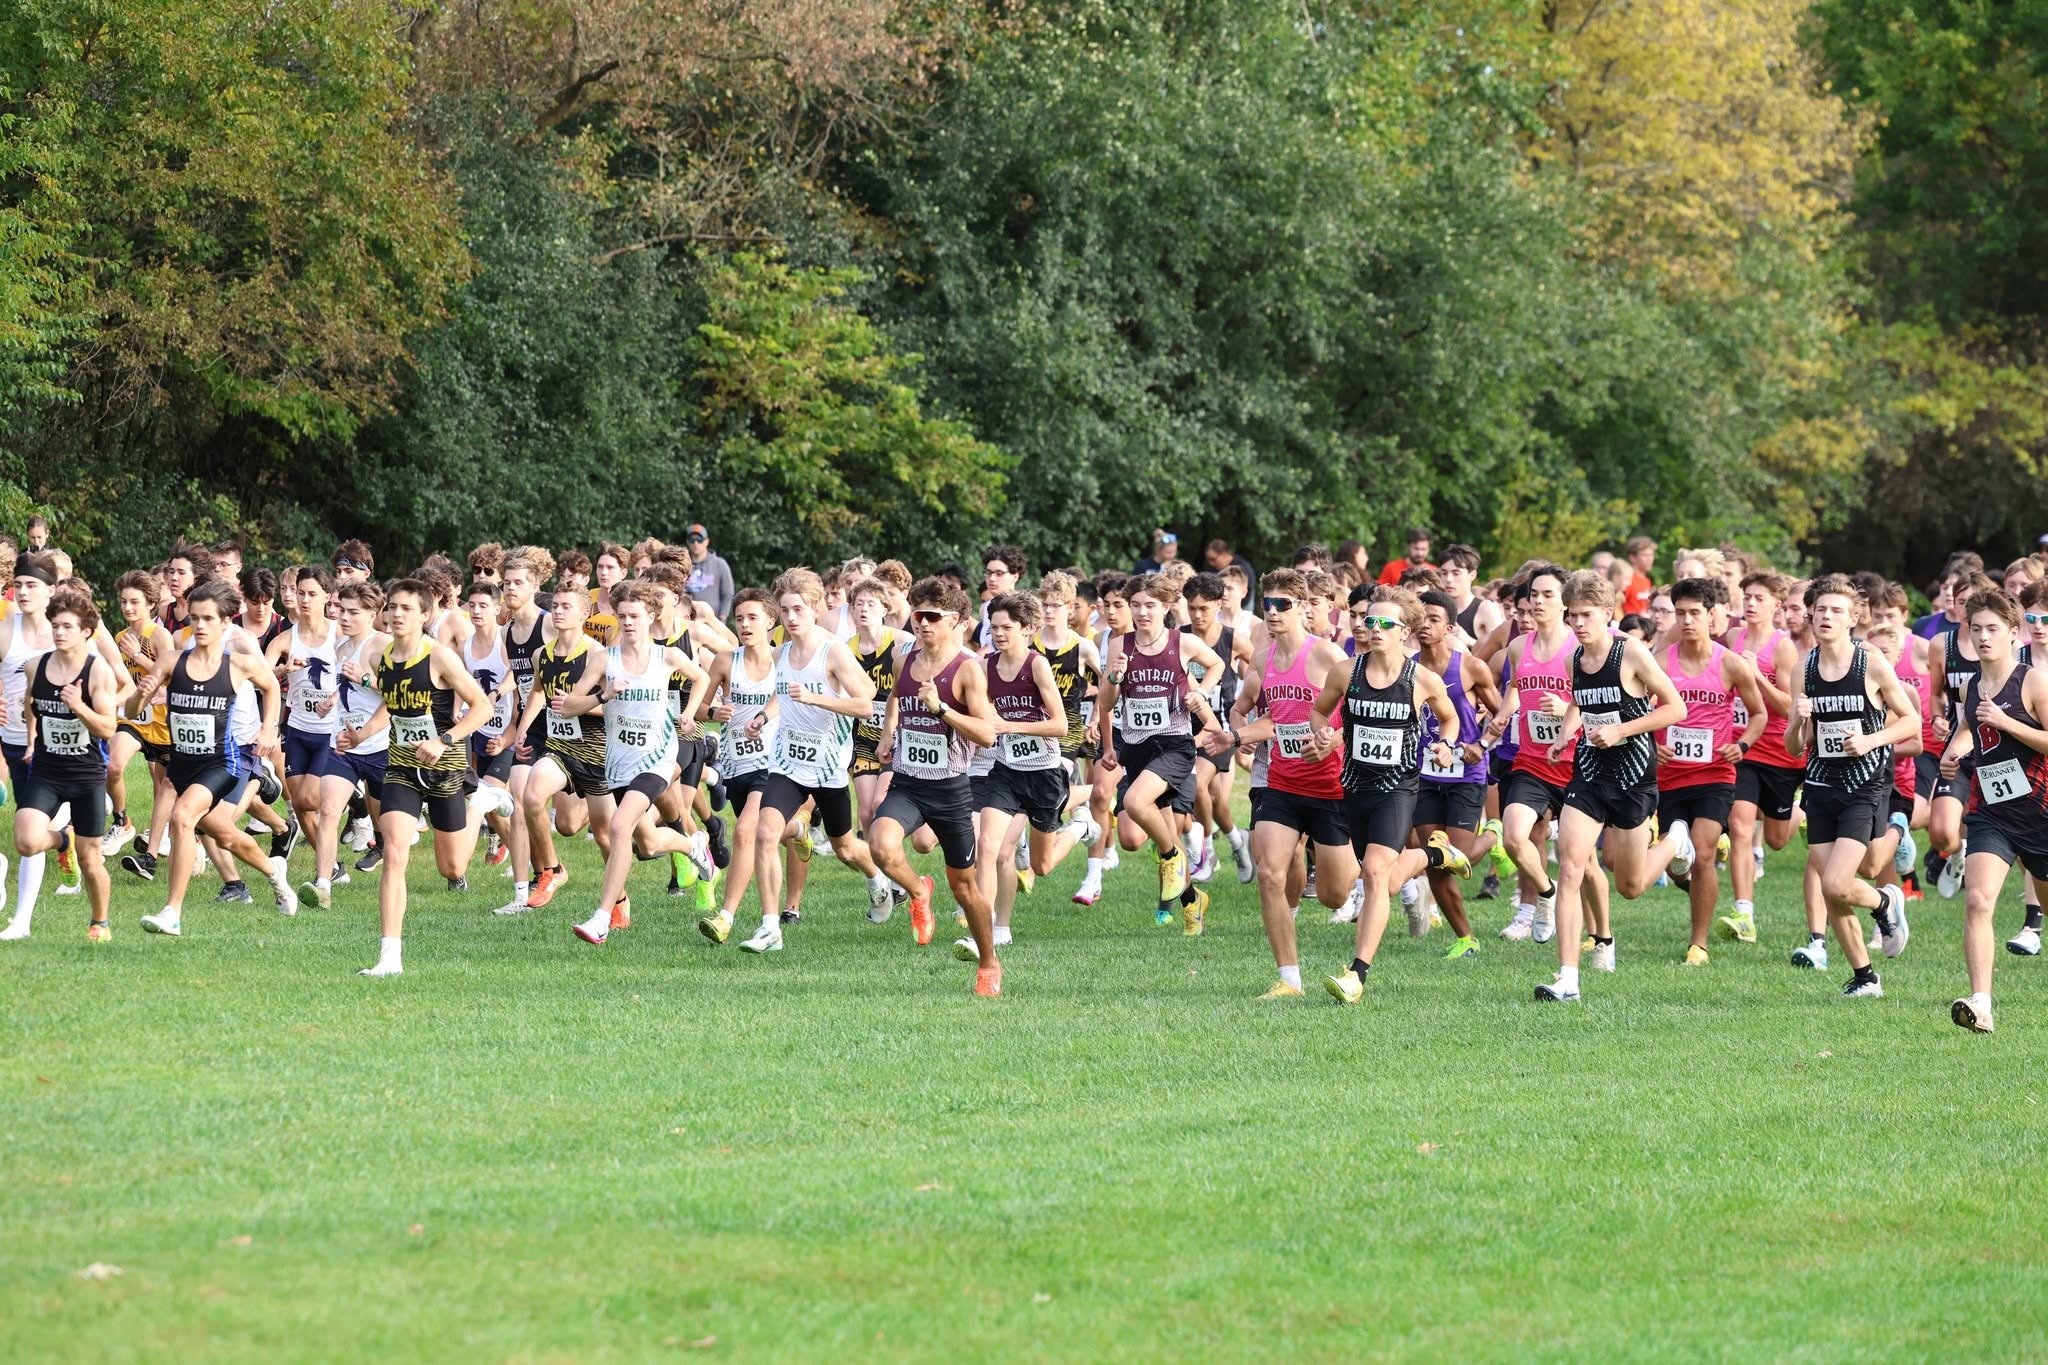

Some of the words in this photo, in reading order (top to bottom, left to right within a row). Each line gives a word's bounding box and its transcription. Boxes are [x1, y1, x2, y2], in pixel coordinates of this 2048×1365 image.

[1127, 669, 1175, 684] CENTRAL
[171, 692, 209, 709] CHRISTIAN
[210, 696, 227, 710] LIFE
[400, 678, 433, 714] Troy
[615, 689, 661, 701] EENDALE
[1265, 685, 1313, 702] RONCOS
[1679, 689, 1726, 706] ONCOS
[1812, 695, 1864, 713] ATERFORD
[625, 721, 652, 729] RUNNER
[1134, 712, 1162, 726] 879
[177, 728, 206, 744] 605
[402, 728, 429, 742] 238
[551, 721, 574, 735] 245
[1680, 732, 1707, 740] RUNNER
[51, 731, 80, 745] 597
[618, 729, 647, 747] 455
[795, 735, 821, 745] RUNNER
[914, 737, 942, 747] RUNNER
[1368, 733, 1397, 742] RUNNER
[1977, 721, 2001, 755] B
[735, 738, 764, 756] 558
[788, 743, 817, 762] 552
[908, 746, 939, 765] 890
[1012, 740, 1040, 758] 884
[1360, 742, 1393, 761] 844
[1674, 741, 1704, 758] 813
[1988, 765, 2017, 778] RUNNER
[1991, 778, 2014, 798] 31
